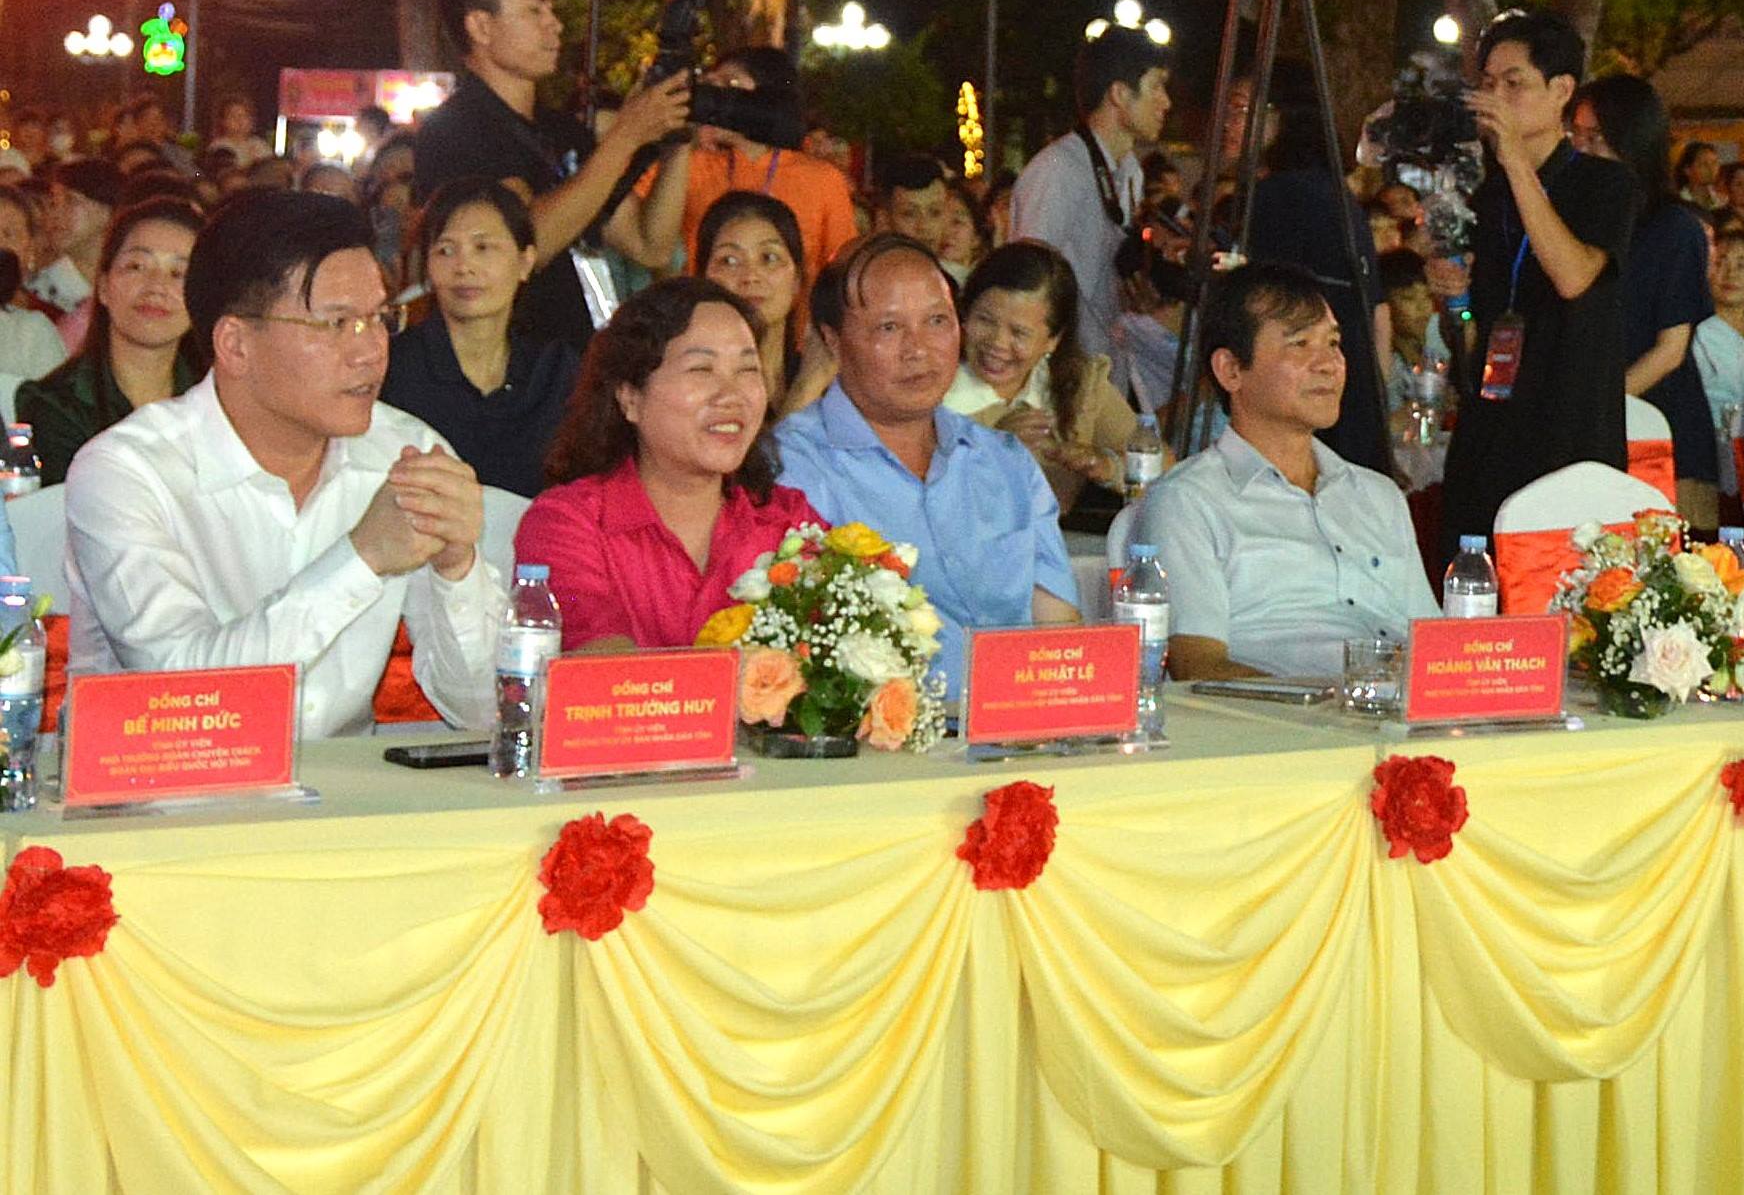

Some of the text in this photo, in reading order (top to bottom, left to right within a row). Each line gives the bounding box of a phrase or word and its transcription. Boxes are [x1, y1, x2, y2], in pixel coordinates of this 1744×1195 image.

[1028, 645, 1083, 663] ĐỒNG CHÍ
[1463, 638, 1514, 653] ĐỒNG CHÍ
[1038, 663, 1076, 684] NHẬT
[1077, 661, 1095, 683] LỆ
[1426, 656, 1547, 675] HOÀNG VĂN THẠCH
[611, 677, 674, 697] ĐỒNG CHÍ
[148, 689, 220, 710] ĐỒNG CHÍ
[564, 704, 612, 723] TRỊNH
[683, 697, 717, 716] HUY
[123, 709, 242, 736] BẾ MINH ĐỨC
